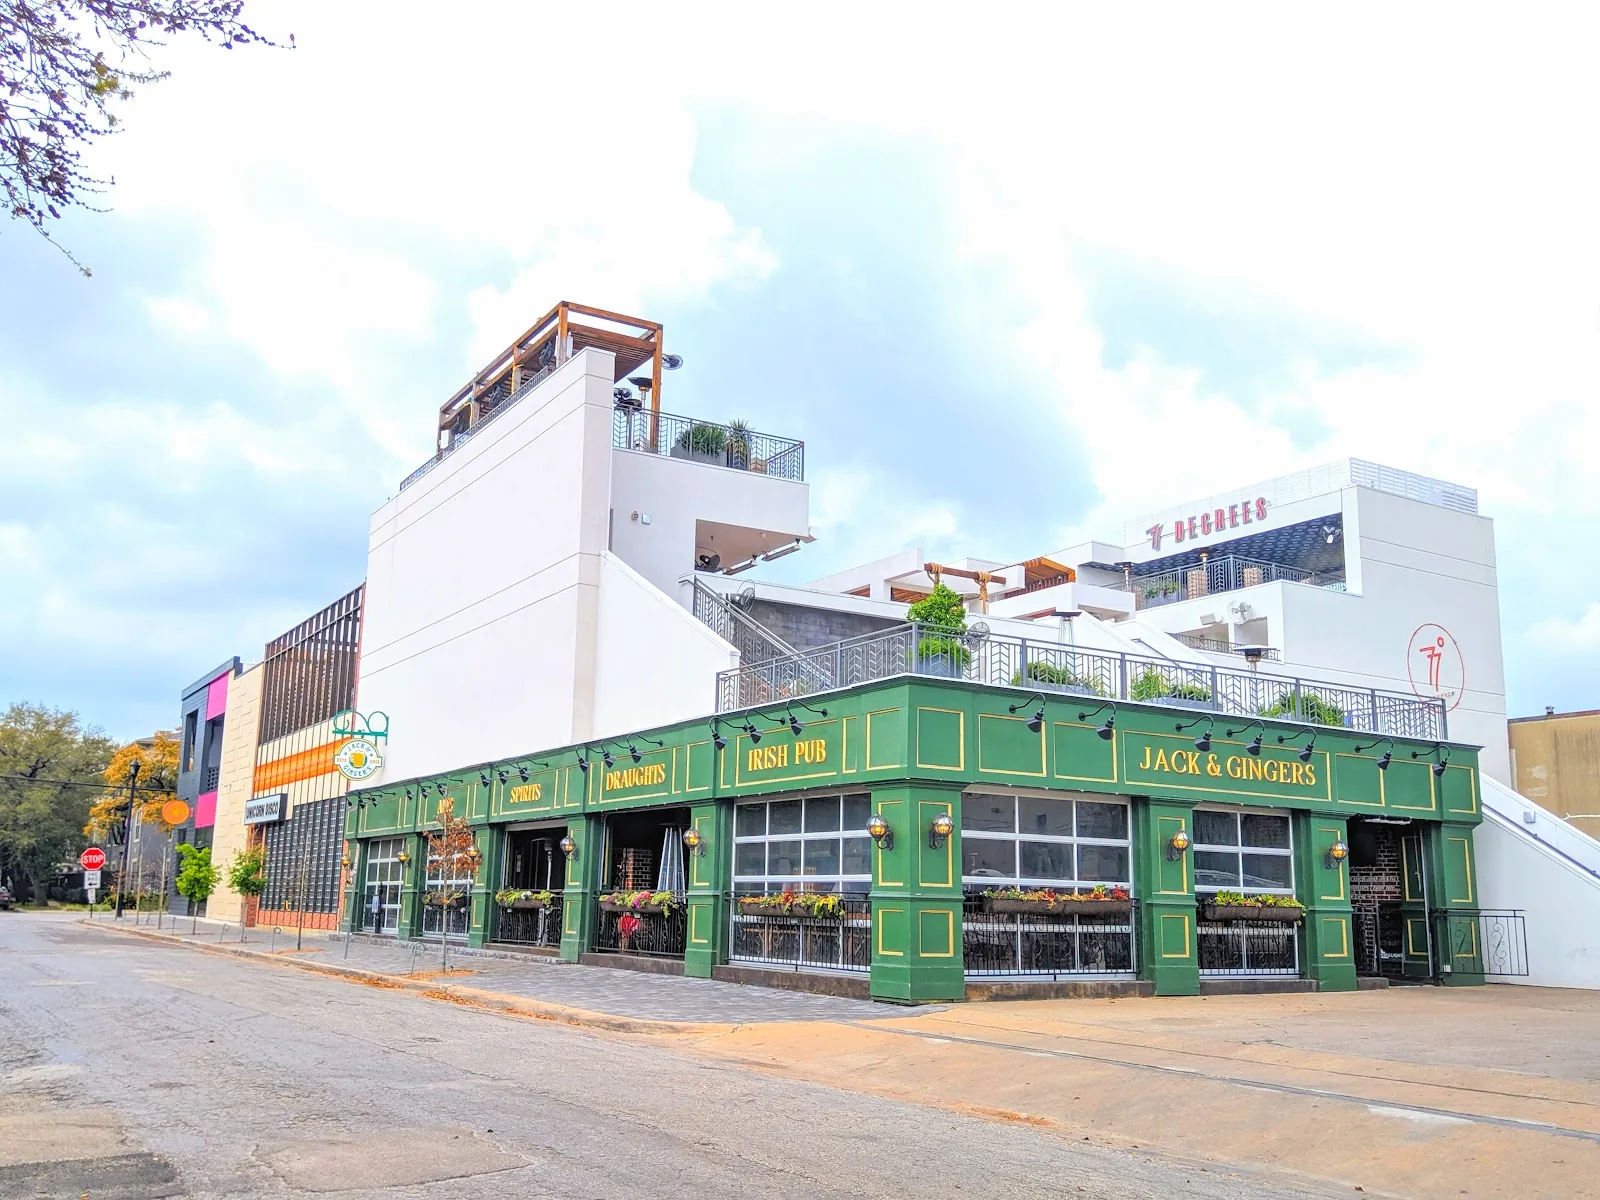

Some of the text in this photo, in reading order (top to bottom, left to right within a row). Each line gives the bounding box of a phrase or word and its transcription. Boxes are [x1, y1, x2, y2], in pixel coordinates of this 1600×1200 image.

[1174, 496, 1268, 543] DEGREES
[347, 742, 365, 752] JACK
[748, 739, 826, 771] IRISH PUB
[605, 763, 666, 791] DRAUGHTS
[1139, 746, 1316, 786] JACK & GINGERS
[510, 783, 541, 804] SPIRITS
[265, 801, 279, 815] DISCO
[83, 854, 104, 864] STOP
